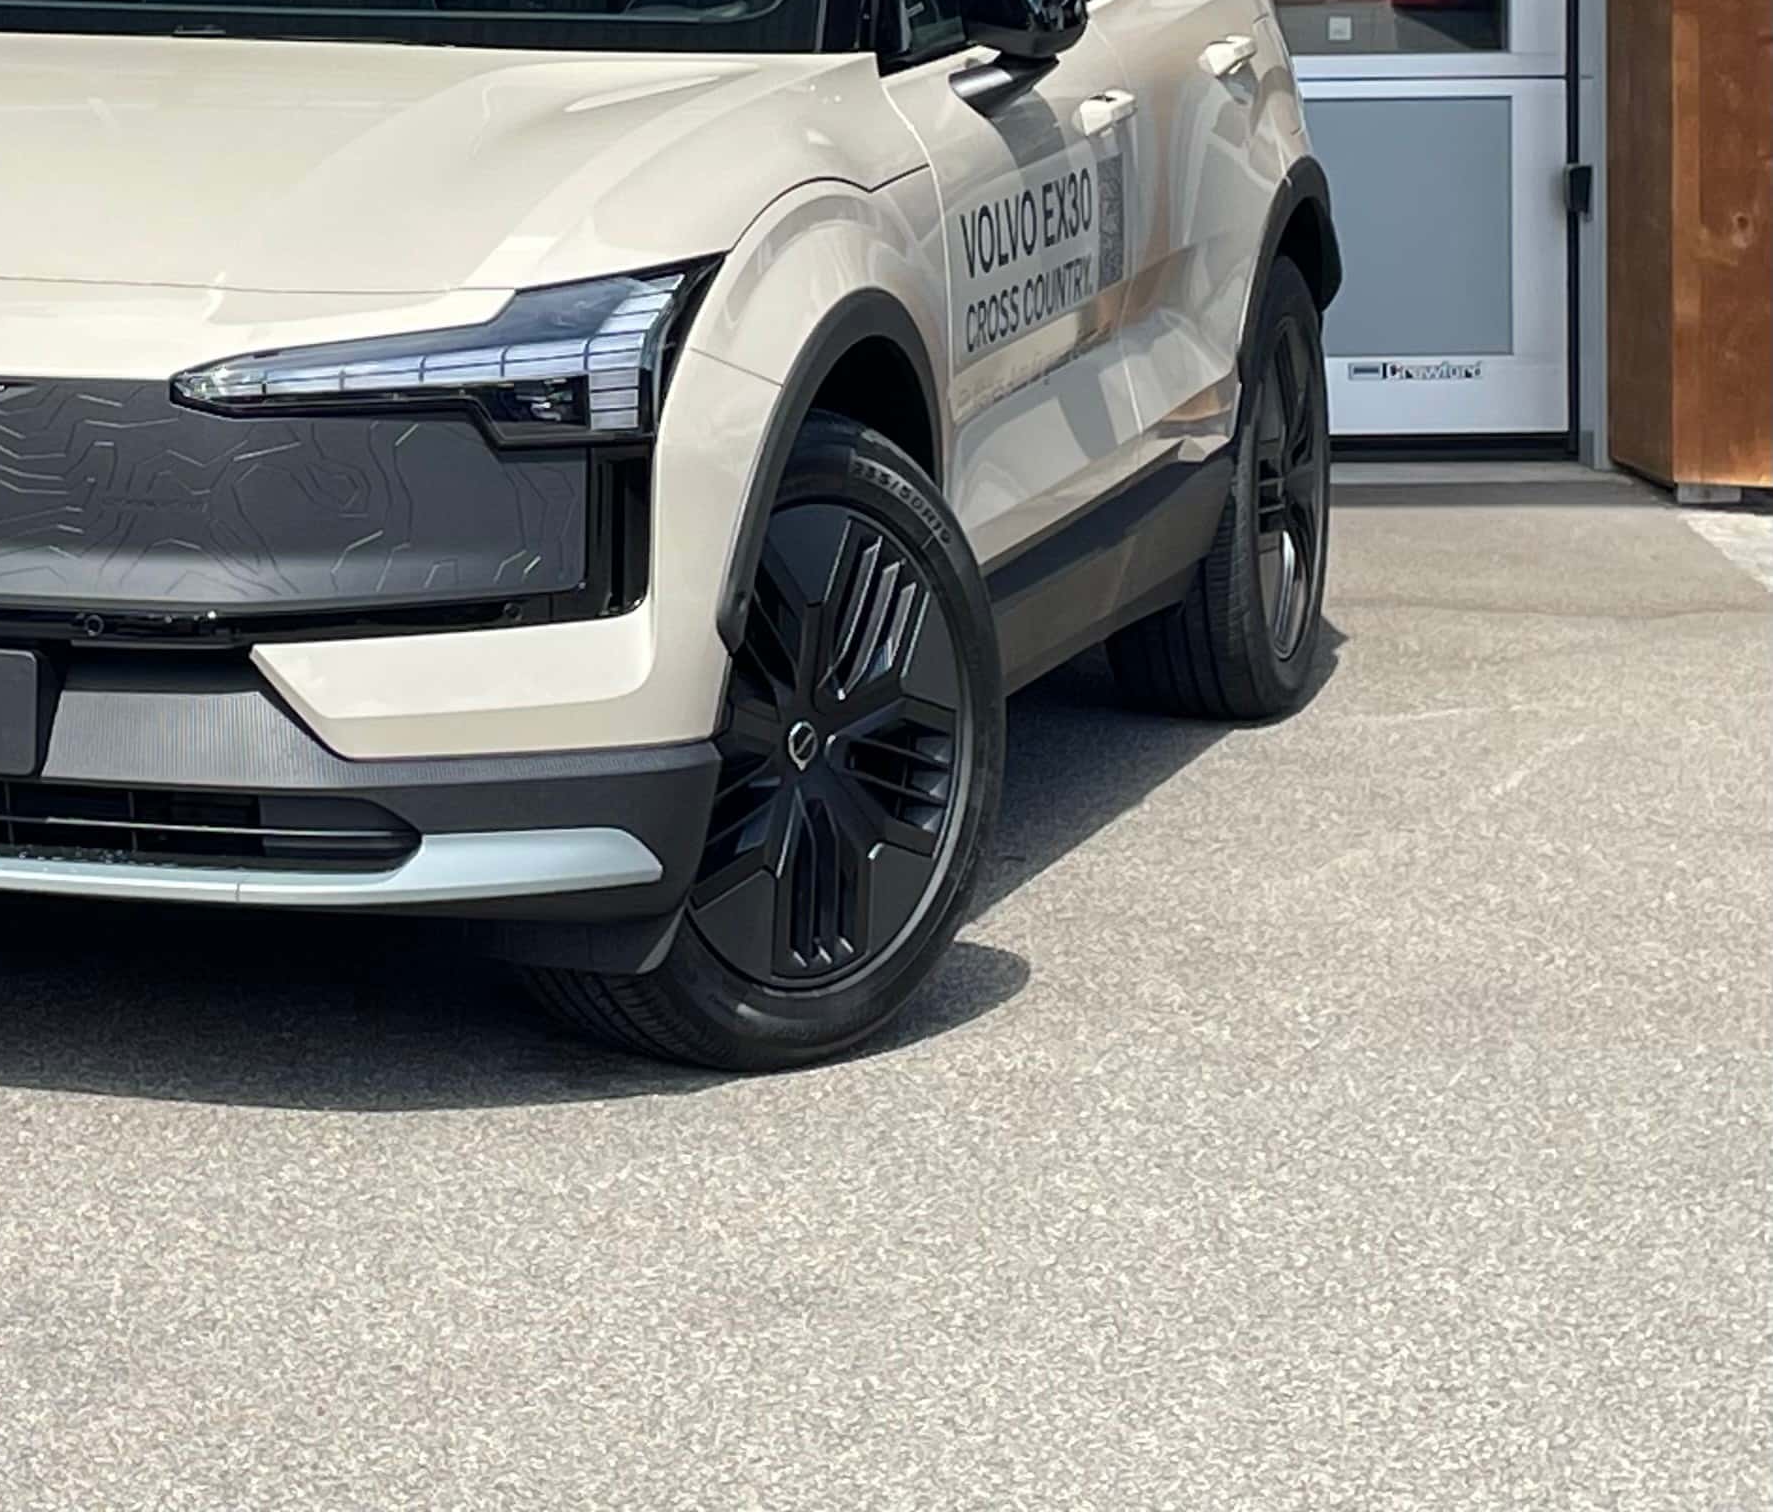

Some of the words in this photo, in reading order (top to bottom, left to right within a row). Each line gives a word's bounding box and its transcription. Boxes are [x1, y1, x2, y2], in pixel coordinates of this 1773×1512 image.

[959, 190, 1037, 278] VOLVO
[1041, 167, 1093, 248] EX30
[965, 285, 1020, 353] CROSS
